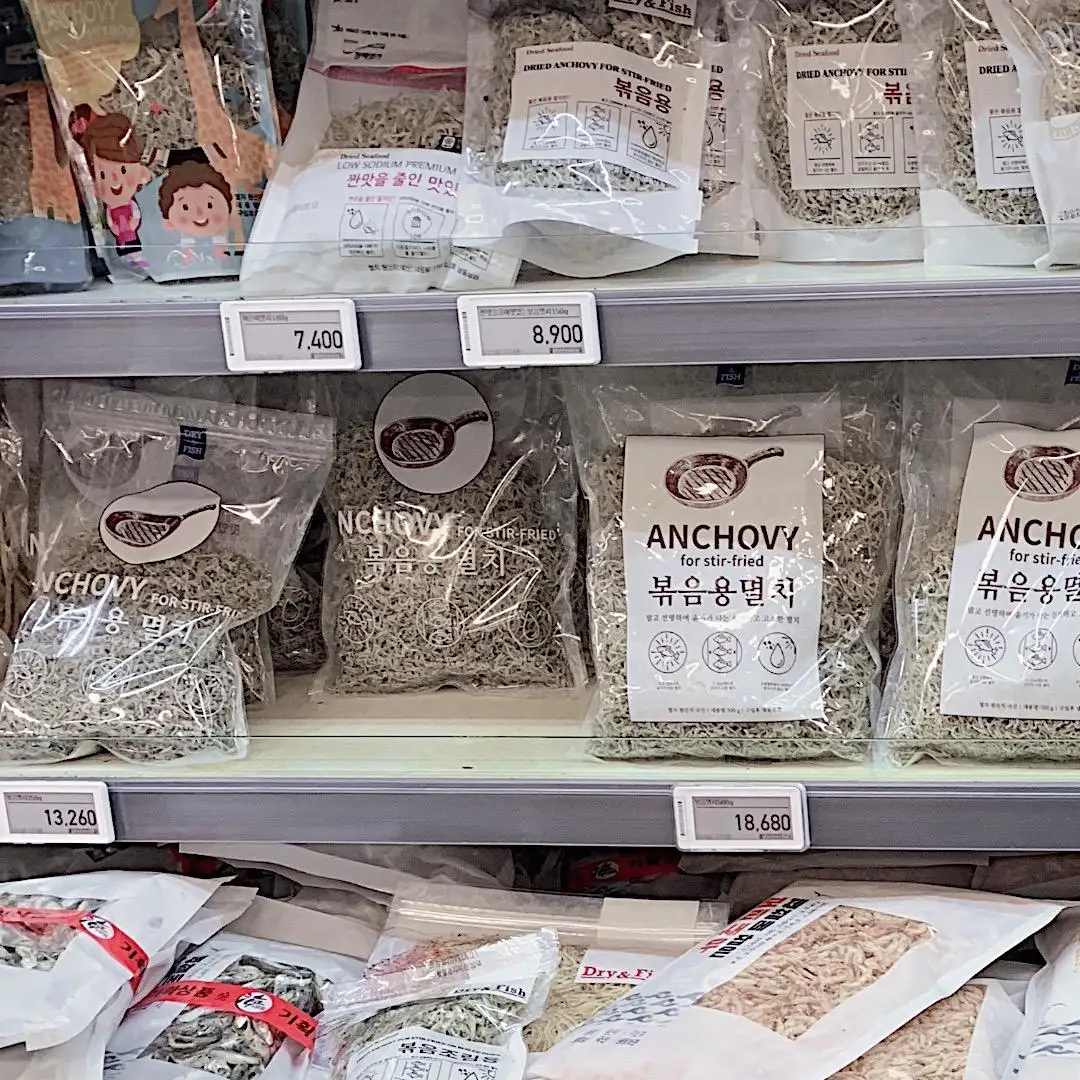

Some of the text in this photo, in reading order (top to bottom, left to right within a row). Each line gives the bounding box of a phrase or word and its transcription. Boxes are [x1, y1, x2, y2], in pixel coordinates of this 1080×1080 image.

[523, 63, 551, 71] DRIED
[553, 61, 599, 70] ANCHOVY
[600, 63, 620, 72] FOR
[796, 69, 821, 79] DRIED
[866, 68, 887, 76] FOR
[614, 77, 672, 114] 볶음용
[337, 161, 458, 176] LOW SODIUM PREMIUM
[347, 172, 460, 199] 짠맛을 줄인 맛있
[183, 445, 203, 455] FISH
[337, 509, 452, 536] NCHOVY
[647, 523, 800, 551] ANCHOVY
[680, 554, 764, 568] for stir-fried
[1010, 549, 1030, 563] for
[38, 570, 178, 608] NCHOVY FOR
